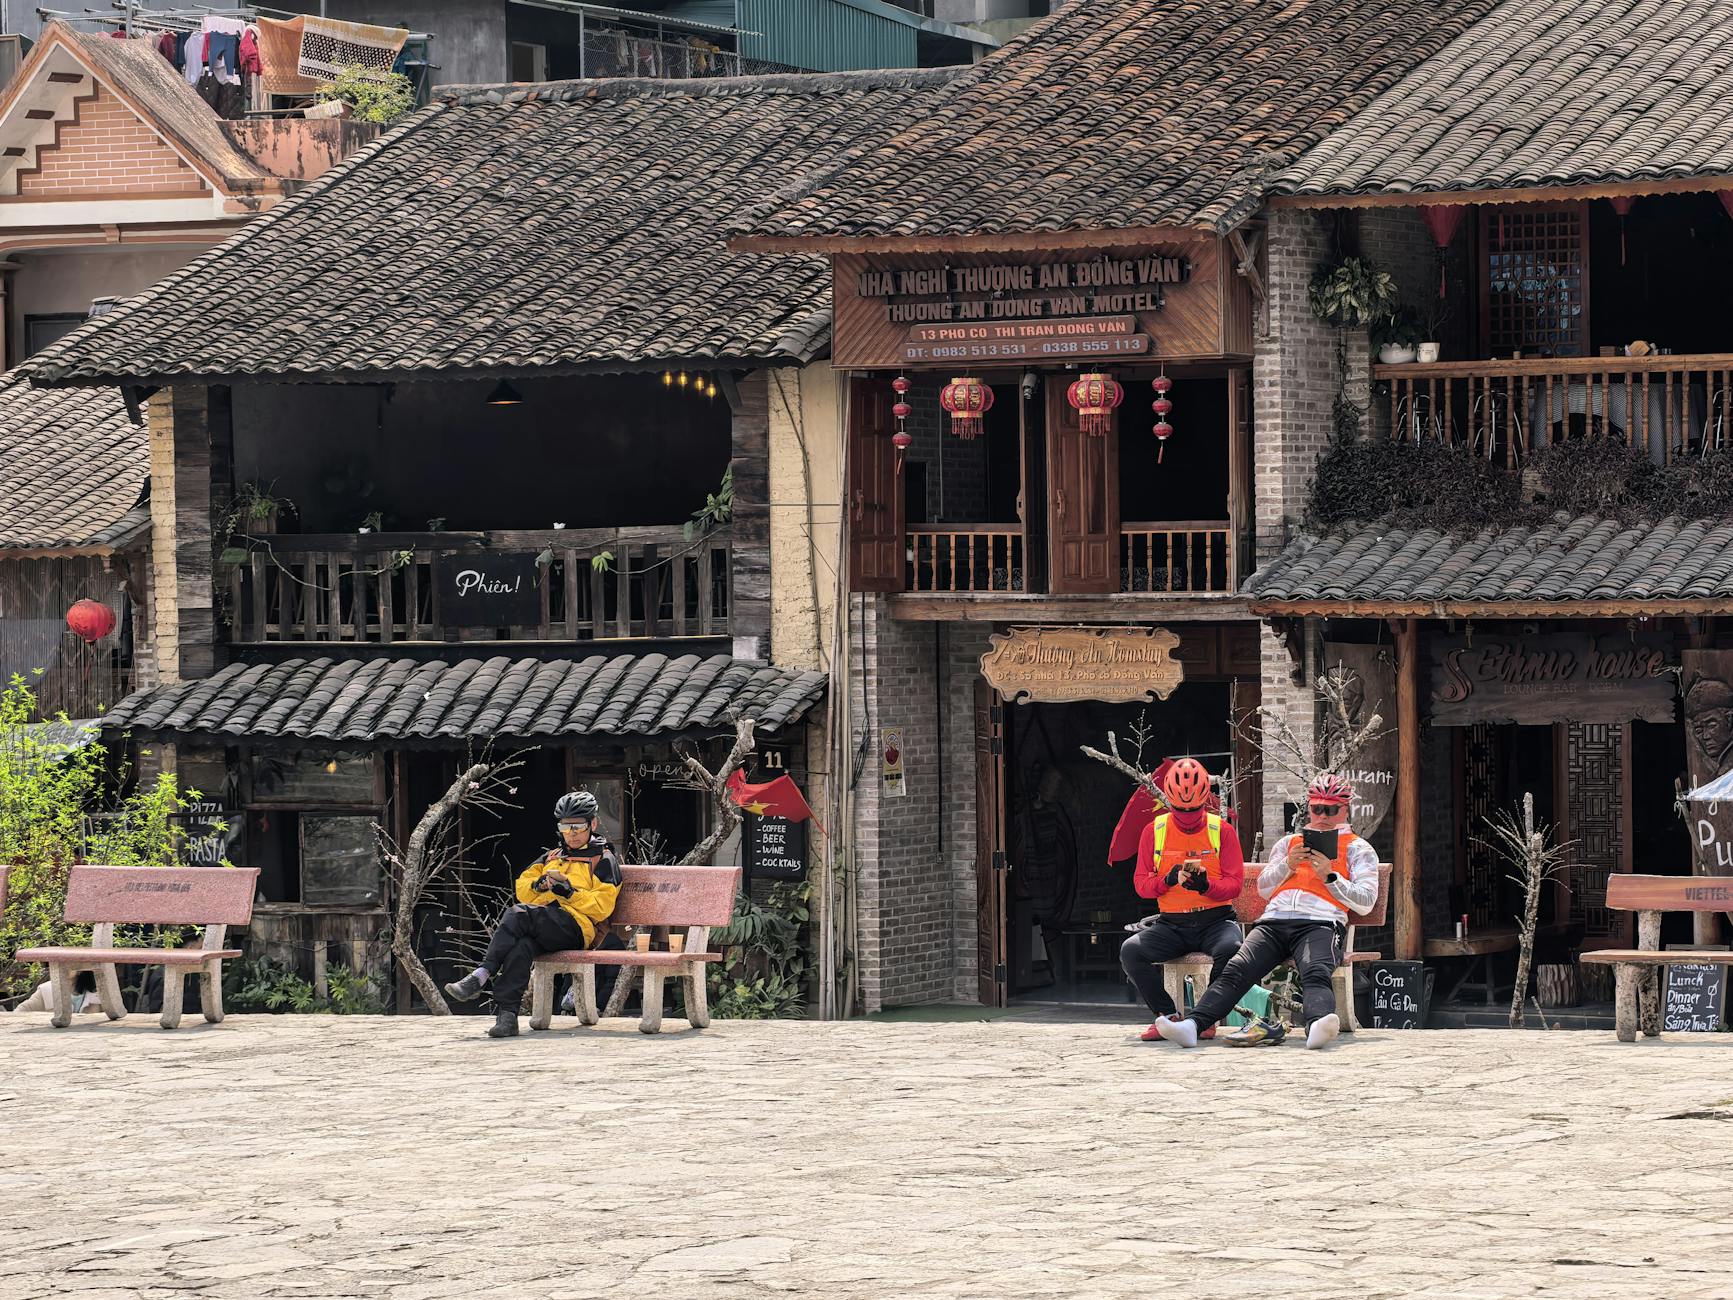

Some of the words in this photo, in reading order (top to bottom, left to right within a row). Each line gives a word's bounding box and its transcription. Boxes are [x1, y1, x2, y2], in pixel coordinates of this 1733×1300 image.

[1039, 263, 1068, 288] AN
[960, 301, 985, 318] AN
[1093, 293, 1157, 313] MOTEL
[921, 330, 936, 340] 13
[932, 346, 967, 357] 0983
[971, 345, 997, 356] 513
[1002, 344, 1026, 355] 531
[1042, 342, 1078, 353] 0338
[1083, 340, 1109, 352] 555
[1115, 339, 1141, 350] 113
[455, 569, 521, 597] Phiên!
[1081, 640, 1103, 664] An
[764, 751, 783, 768] 11
[762, 825, 787, 833] COFFEE
[762, 833, 786, 844] BEER
[1668, 971, 1704, 987] Lunch
[1667, 989, 1702, 1004] Dinner
